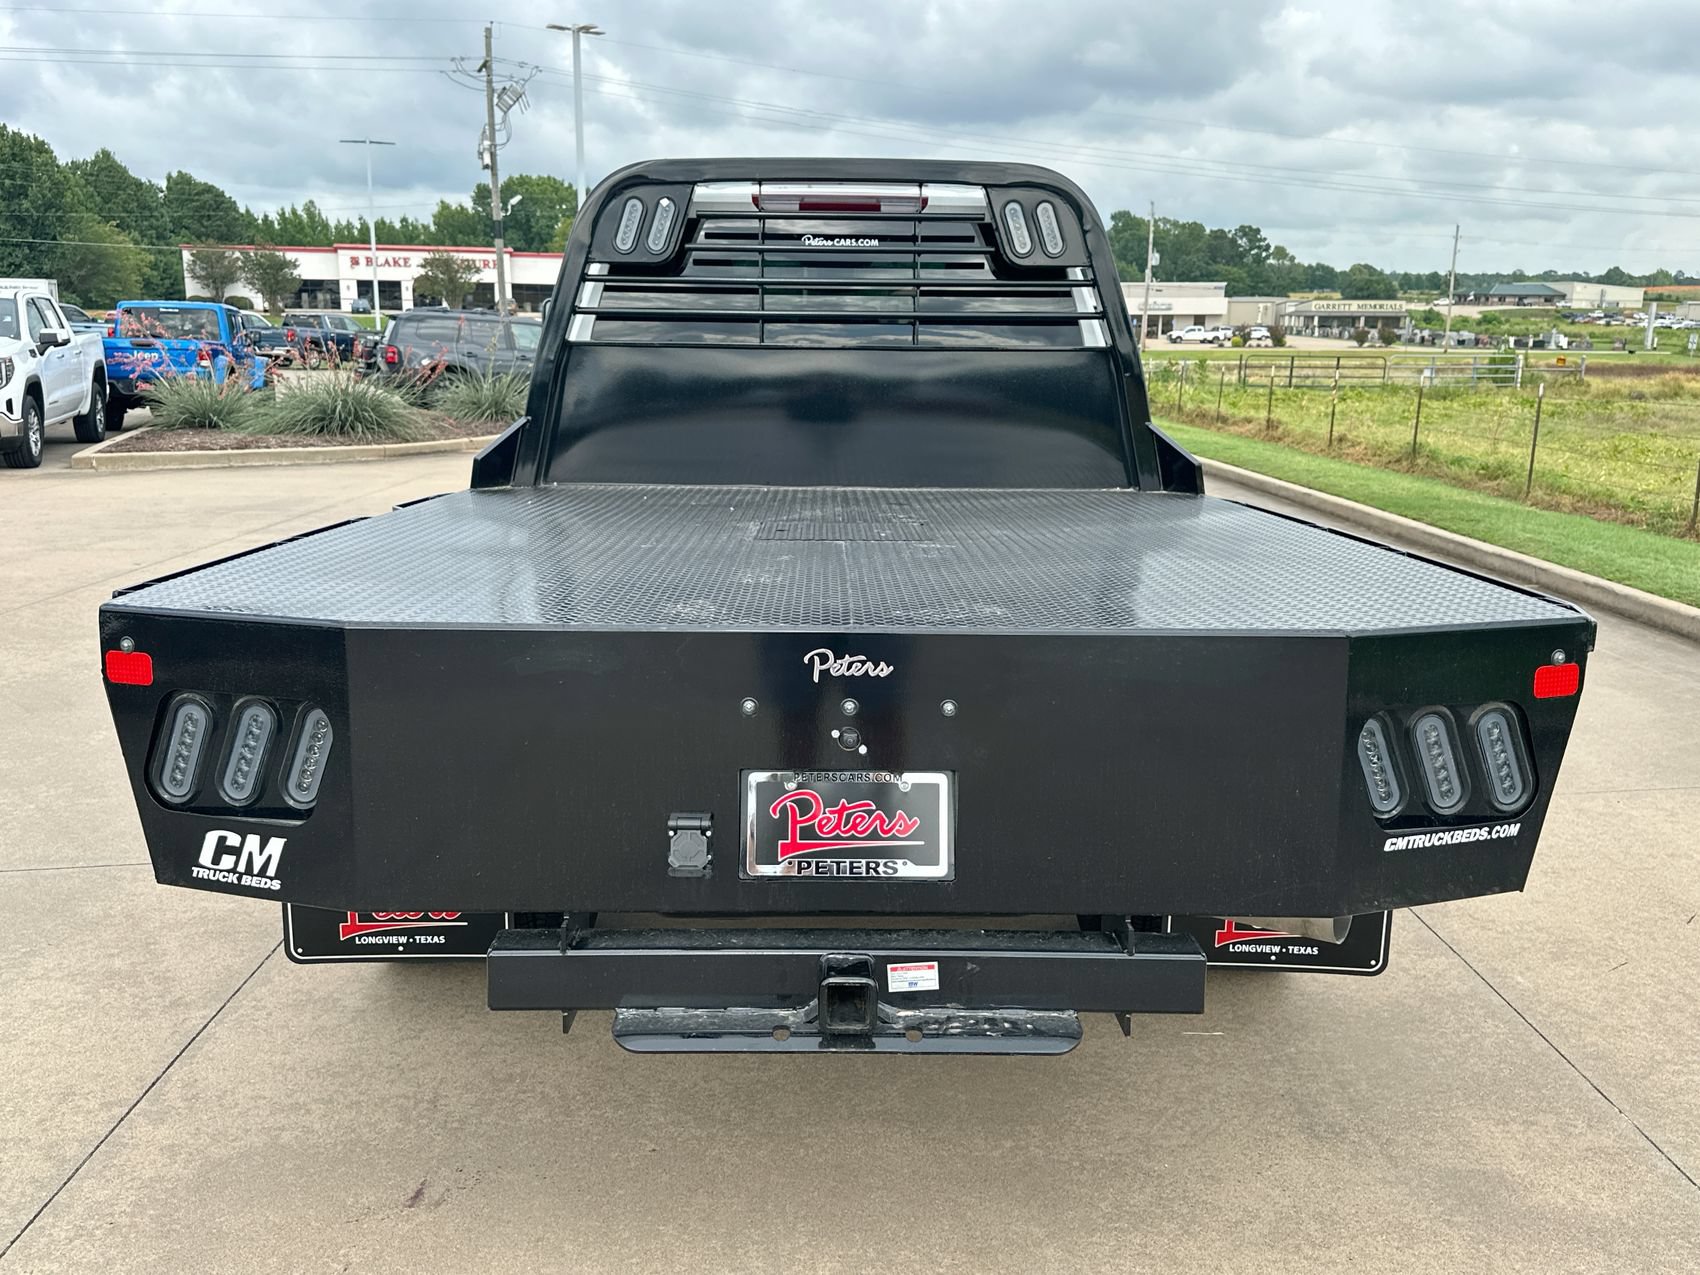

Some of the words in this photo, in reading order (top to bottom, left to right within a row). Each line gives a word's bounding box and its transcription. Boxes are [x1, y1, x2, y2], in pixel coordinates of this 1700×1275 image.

[365, 256, 411, 268] BLAKE
[1314, 303, 1352, 311] GARRETT
[1357, 303, 1403, 311] MEMORIALS
[803, 648, 894, 683] Peters
[769, 789, 920, 861] Peters
[1383, 823, 1521, 852] CMTRUCKBEDS.COM
[198, 829, 288, 877] CM
[796, 860, 898, 875] PETERS
[191, 866, 240, 884] TRUCK
[240, 875, 282, 890] BEDS
[355, 936, 408, 945] LONGVIEW
[414, 936, 446, 944] TEXAS
[1229, 944, 1281, 954] LONGVIEW
[1287, 946, 1319, 955] TEXAS
